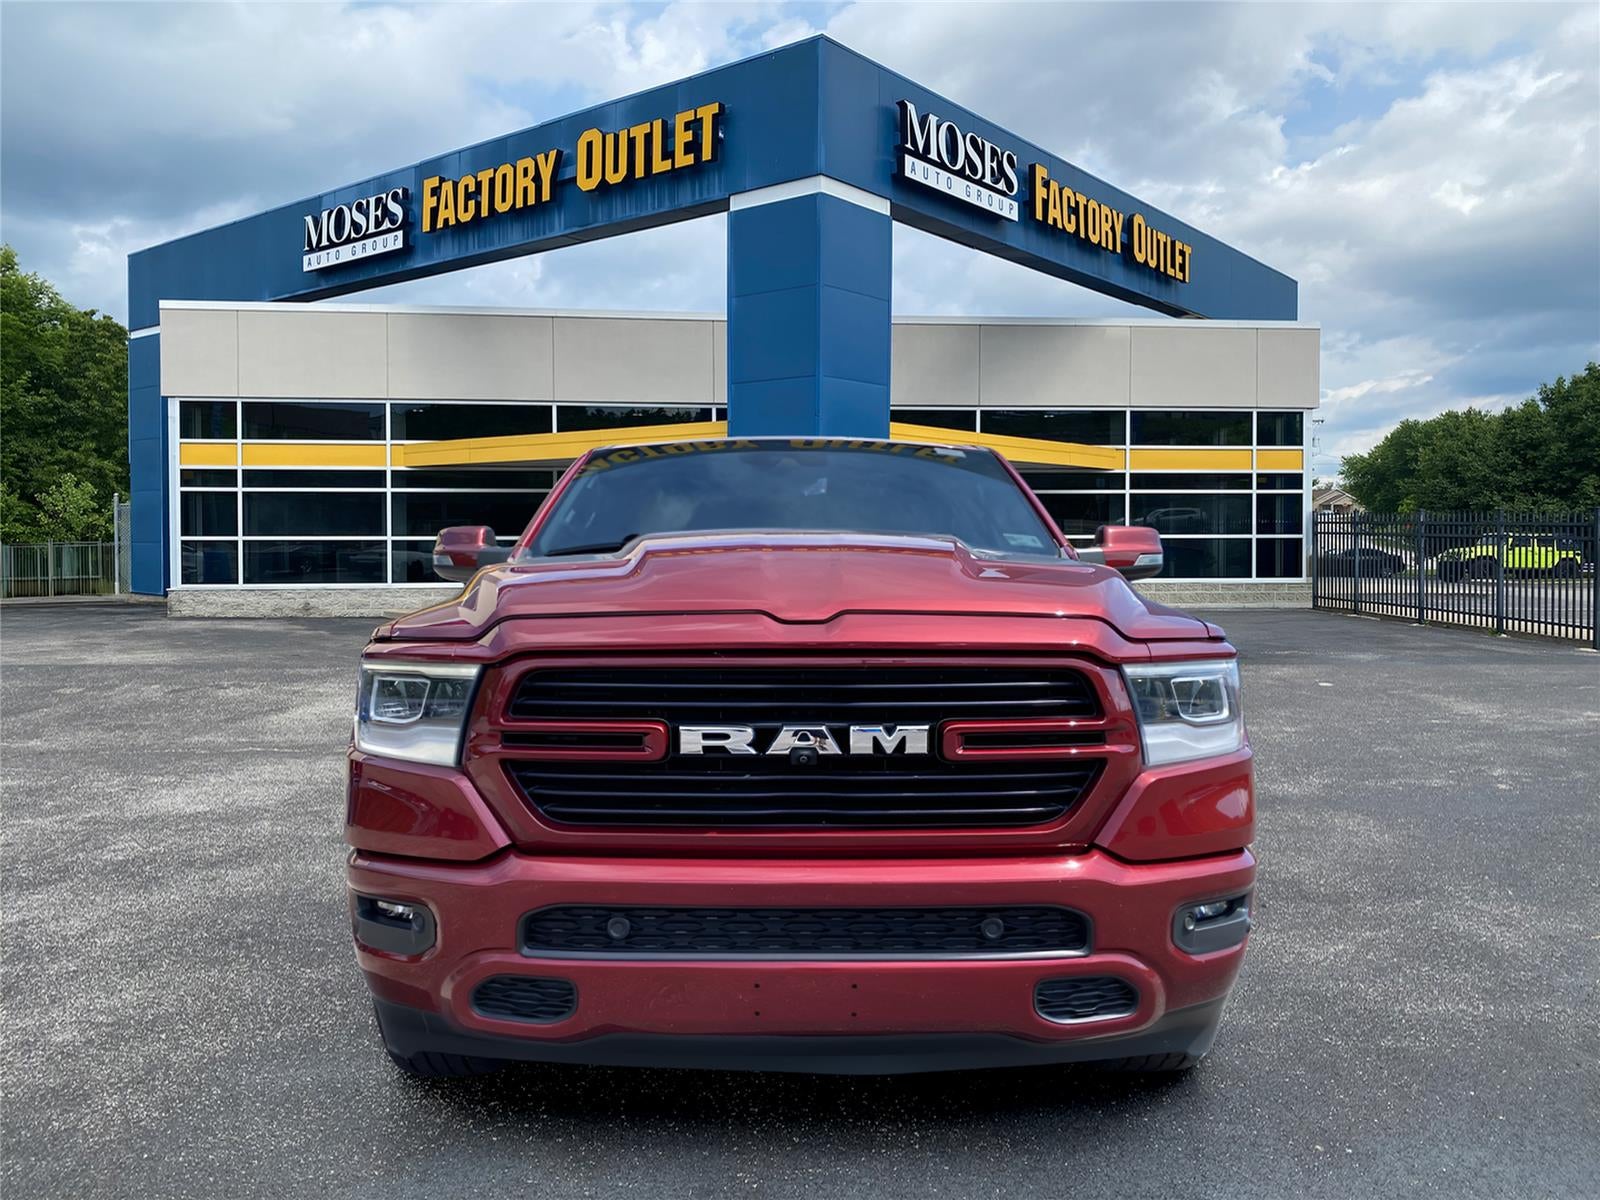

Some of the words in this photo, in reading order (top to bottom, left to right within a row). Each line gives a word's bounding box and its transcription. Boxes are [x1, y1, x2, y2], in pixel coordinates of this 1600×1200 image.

[422, 149, 559, 232] FACTORY
[577, 102, 720, 191] OUTLET
[904, 100, 1018, 196] MOSES
[910, 161, 953, 190] AUTO
[965, 185, 1014, 214] GROUP
[303, 188, 404, 252] MOSES
[306, 250, 341, 267] AUTO
[351, 234, 399, 256] GROUP
[1034, 163, 1124, 254] FACTORY
[1132, 213, 1192, 283] OUTLET
[679, 725, 930, 754] RAM
